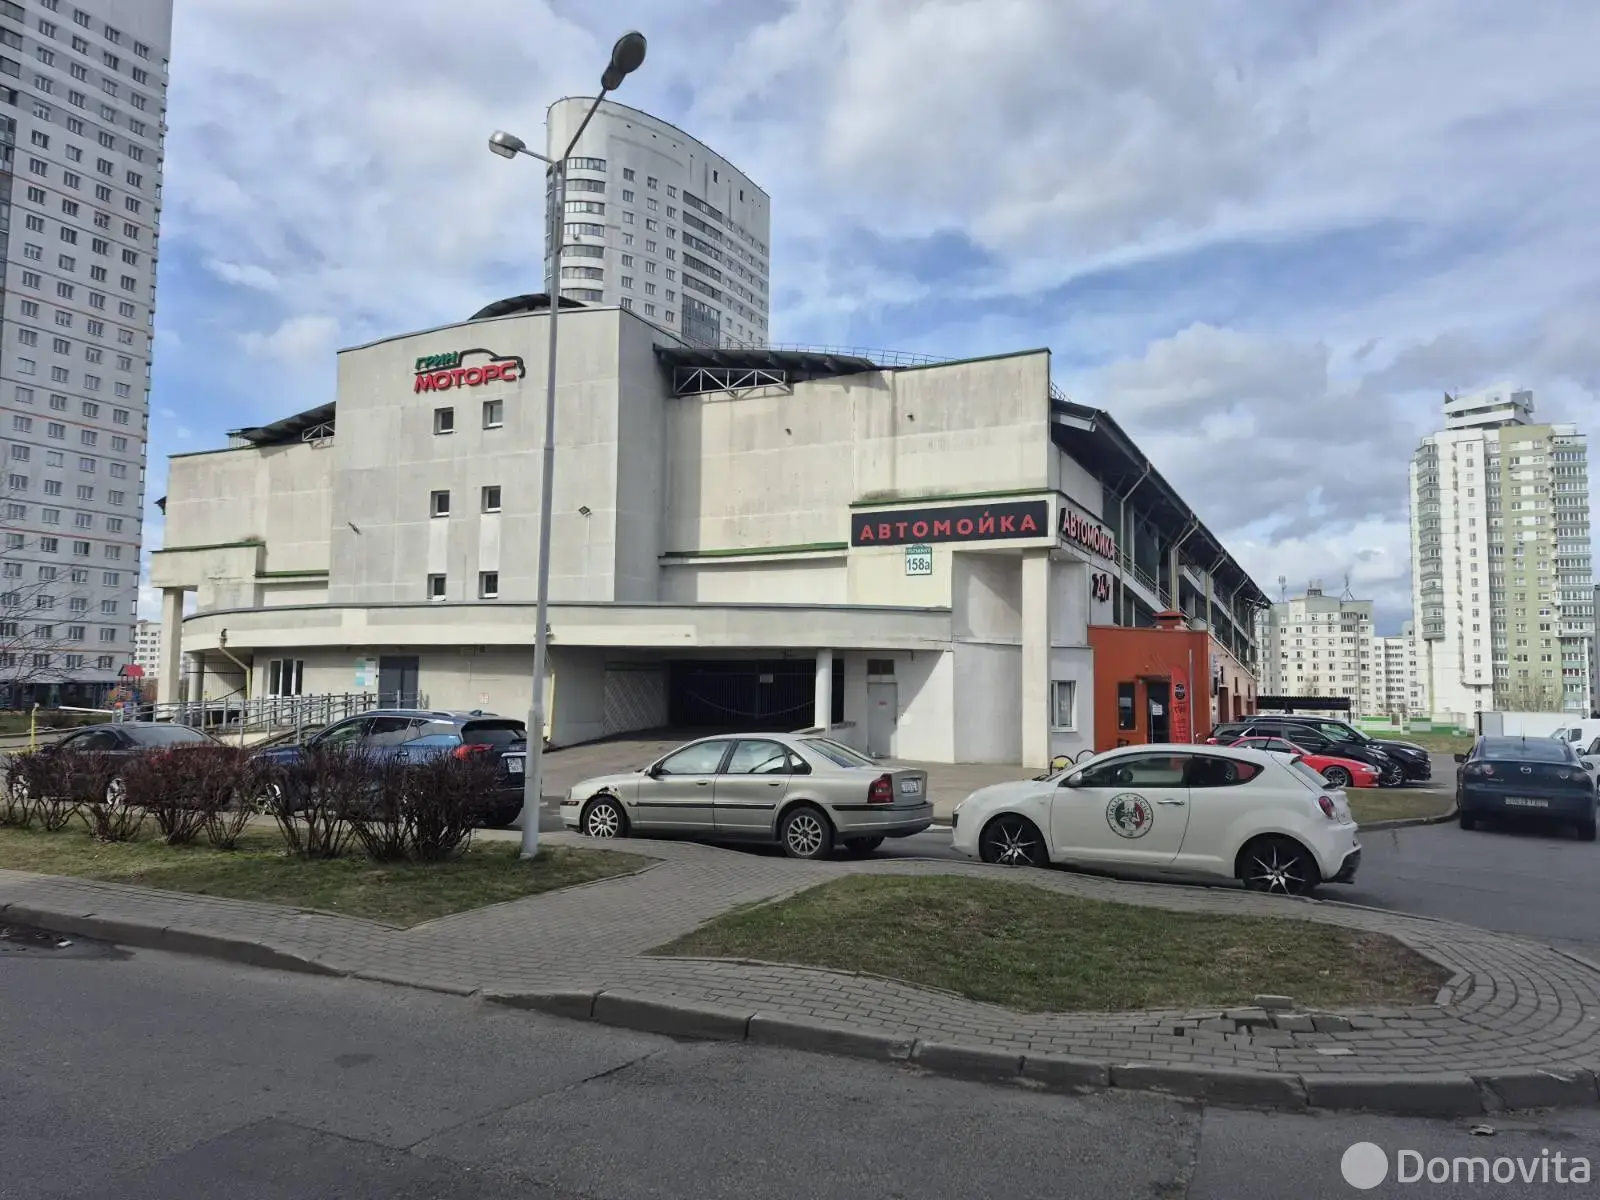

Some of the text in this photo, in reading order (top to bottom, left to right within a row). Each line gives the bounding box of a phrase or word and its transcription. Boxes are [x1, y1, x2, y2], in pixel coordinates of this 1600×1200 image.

[415, 351, 458, 370] ГРИН
[414, 362, 517, 393] МОТОРС
[860, 511, 1037, 541] АВТОМОЙКА
[1061, 508, 1116, 560] АВТОМОЙКА
